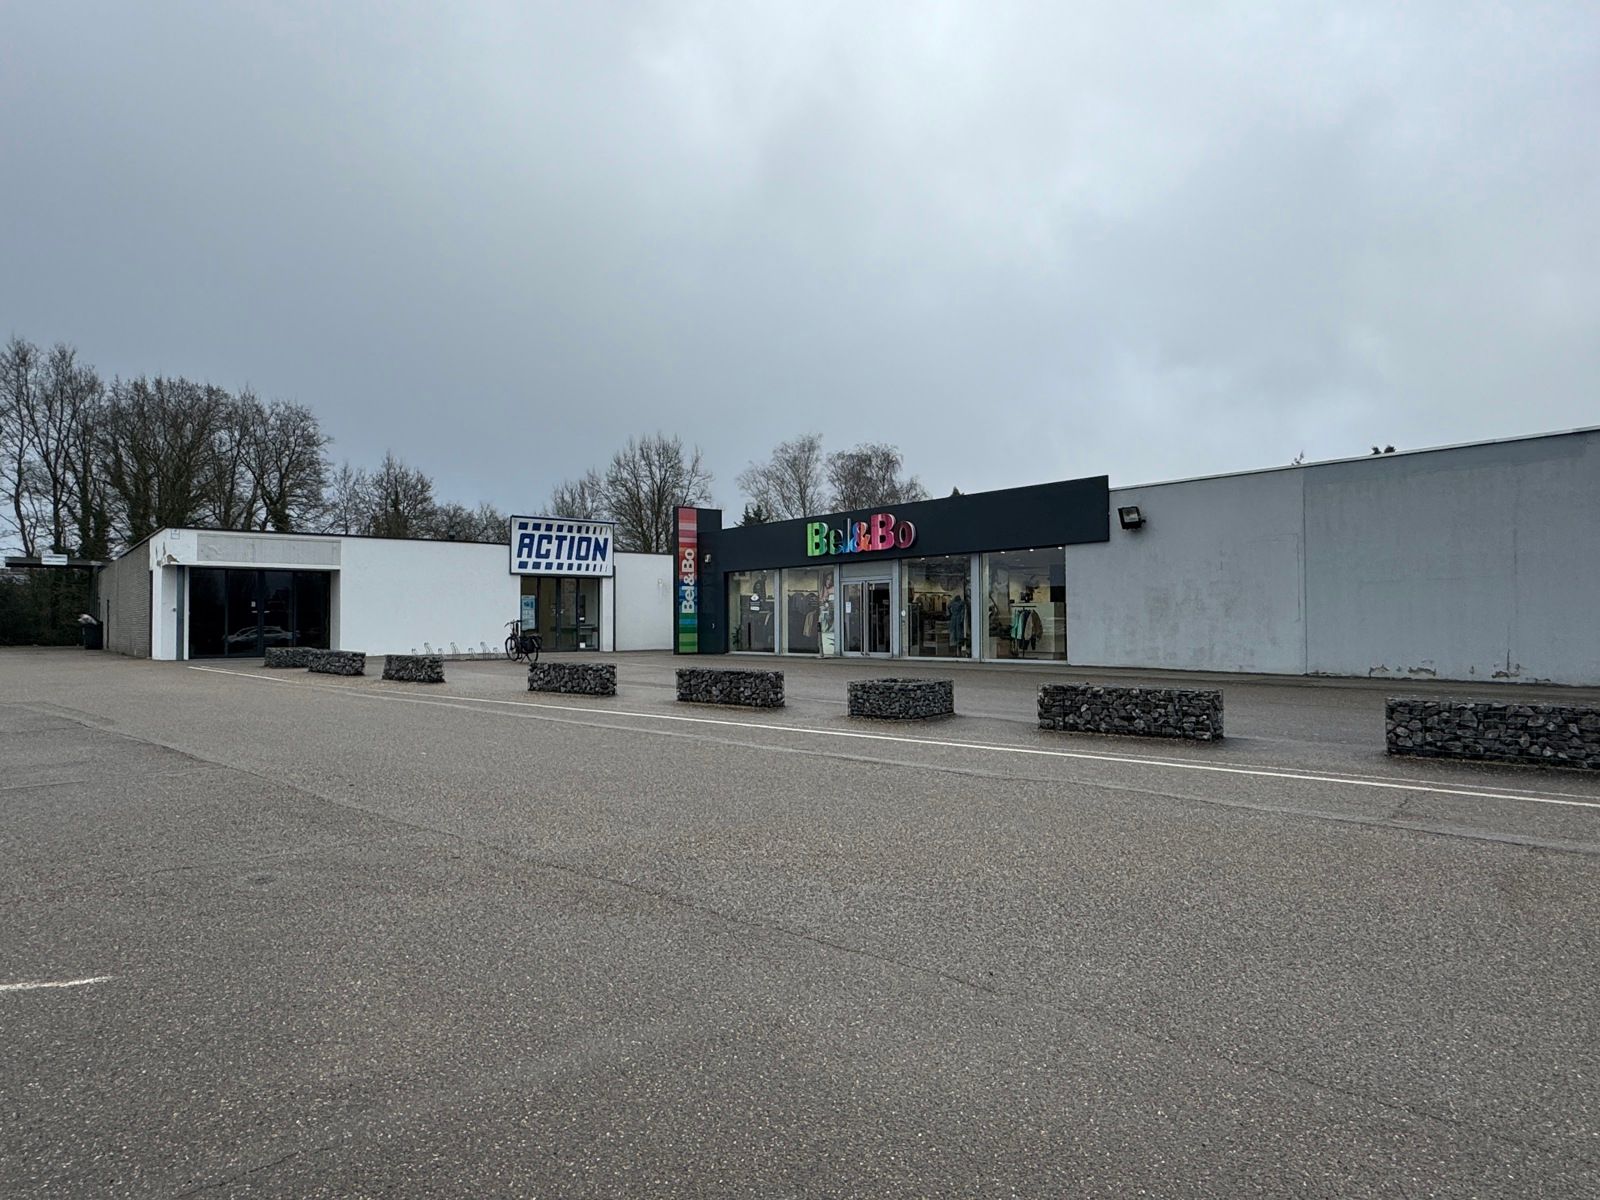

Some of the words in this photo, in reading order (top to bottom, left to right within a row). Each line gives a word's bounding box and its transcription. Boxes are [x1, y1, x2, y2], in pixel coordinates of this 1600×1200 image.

[517, 533, 609, 562] ACTION
[807, 513, 916, 557] Bel&Bo
[681, 549, 695, 614] Bel&Bo
